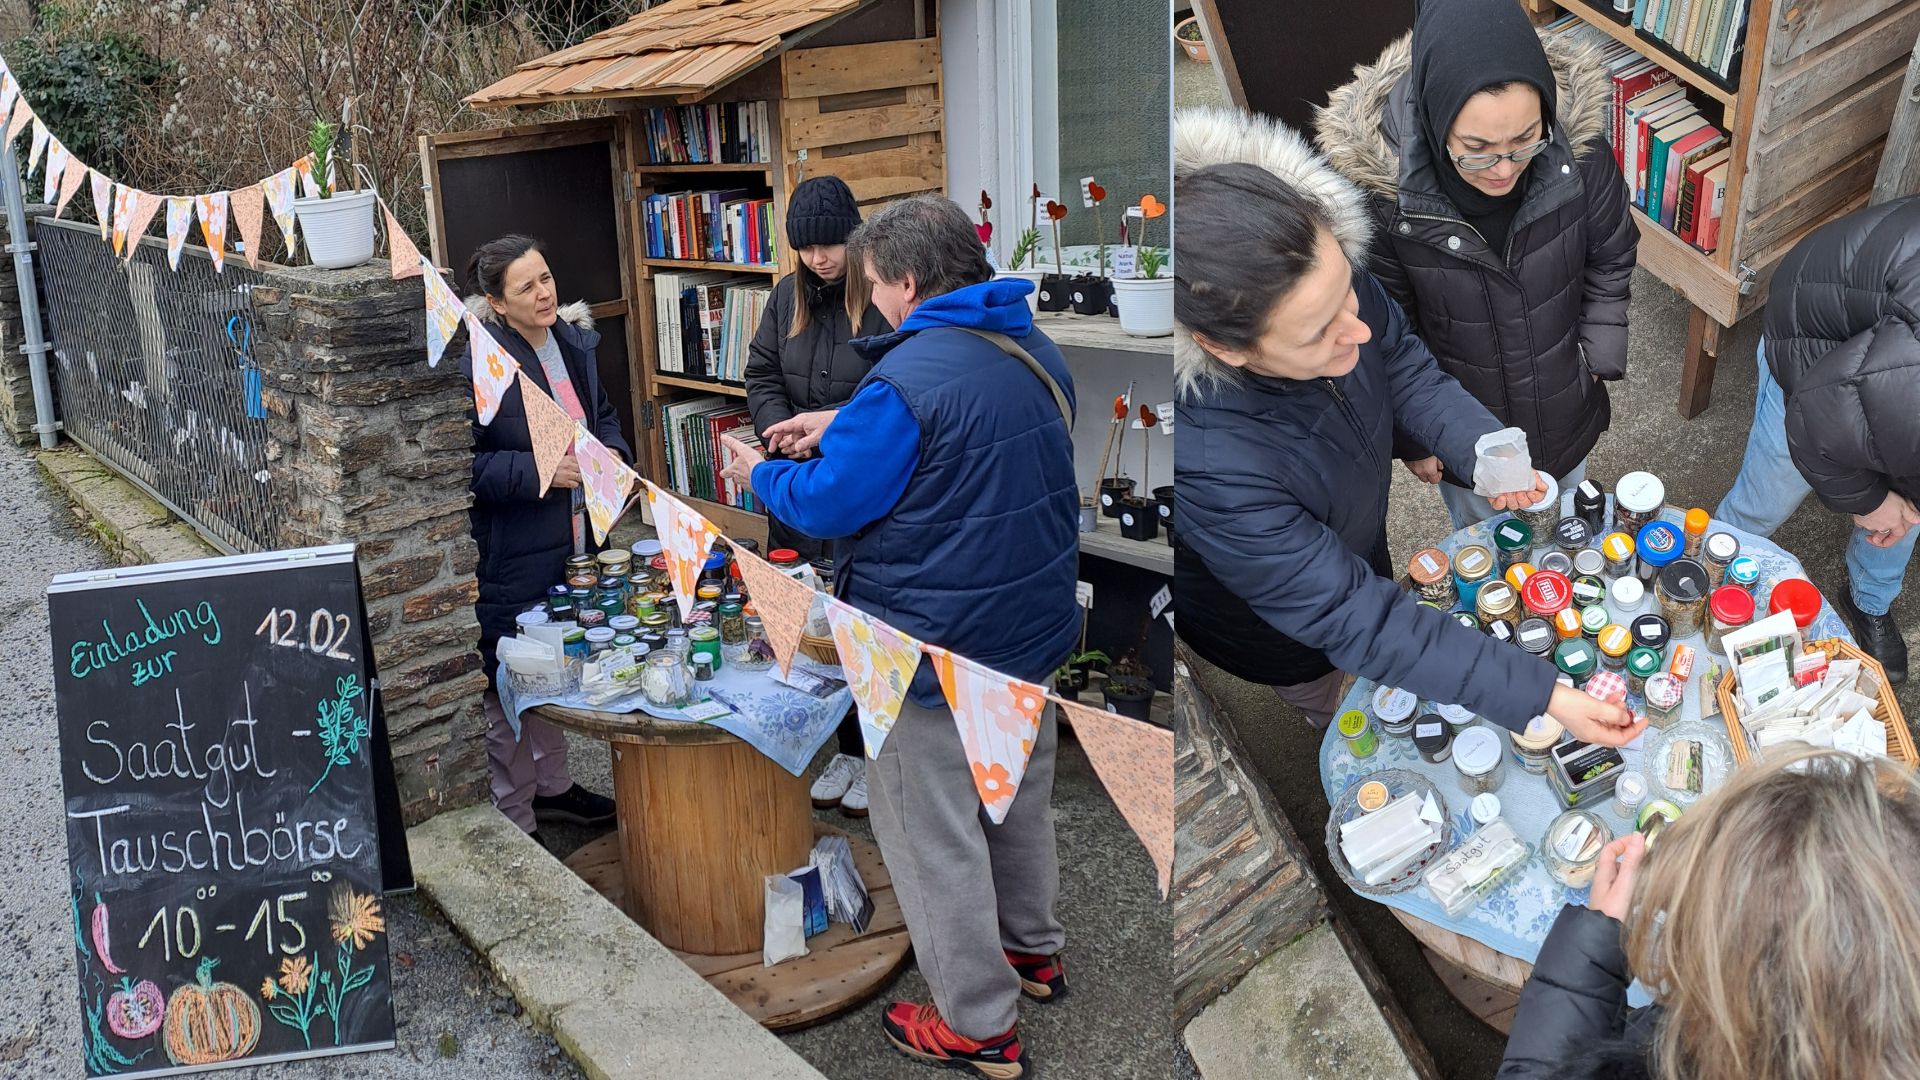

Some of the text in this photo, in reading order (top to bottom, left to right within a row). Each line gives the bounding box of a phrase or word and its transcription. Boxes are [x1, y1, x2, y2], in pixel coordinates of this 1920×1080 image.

[709, 309, 722, 321] DAS
[1538, 580, 1558, 602] FELIX
[70, 599, 221, 678] Einladung
[131, 650, 177, 686] zur
[82, 680, 276, 808] Saatgut
[68, 792, 363, 877] Tauschbörse
[1445, 834, 1492, 875] Saatgut
